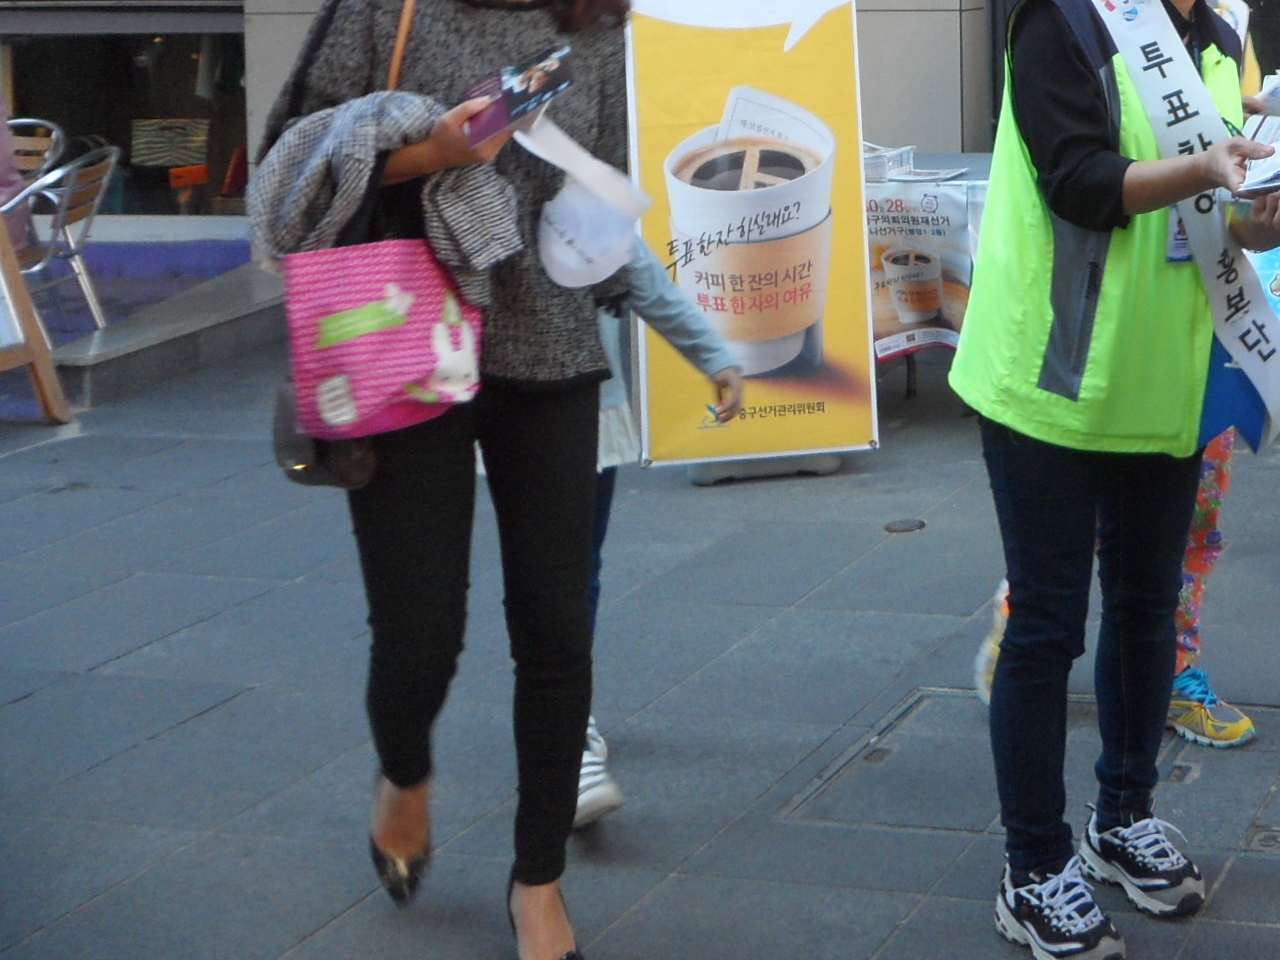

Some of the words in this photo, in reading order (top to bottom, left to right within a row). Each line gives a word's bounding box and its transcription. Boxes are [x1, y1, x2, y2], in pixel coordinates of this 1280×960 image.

[665, 238, 695, 283] 투표
[736, 201, 801, 243] 하실래요?
[694, 270, 726, 291] 커피
[728, 272, 745, 292] 한
[747, 269, 779, 291] 잔의
[782, 259, 813, 283] 시간
[697, 292, 728, 312] 투표
[730, 295, 746, 315] 한
[782, 282, 813, 304] 여유
